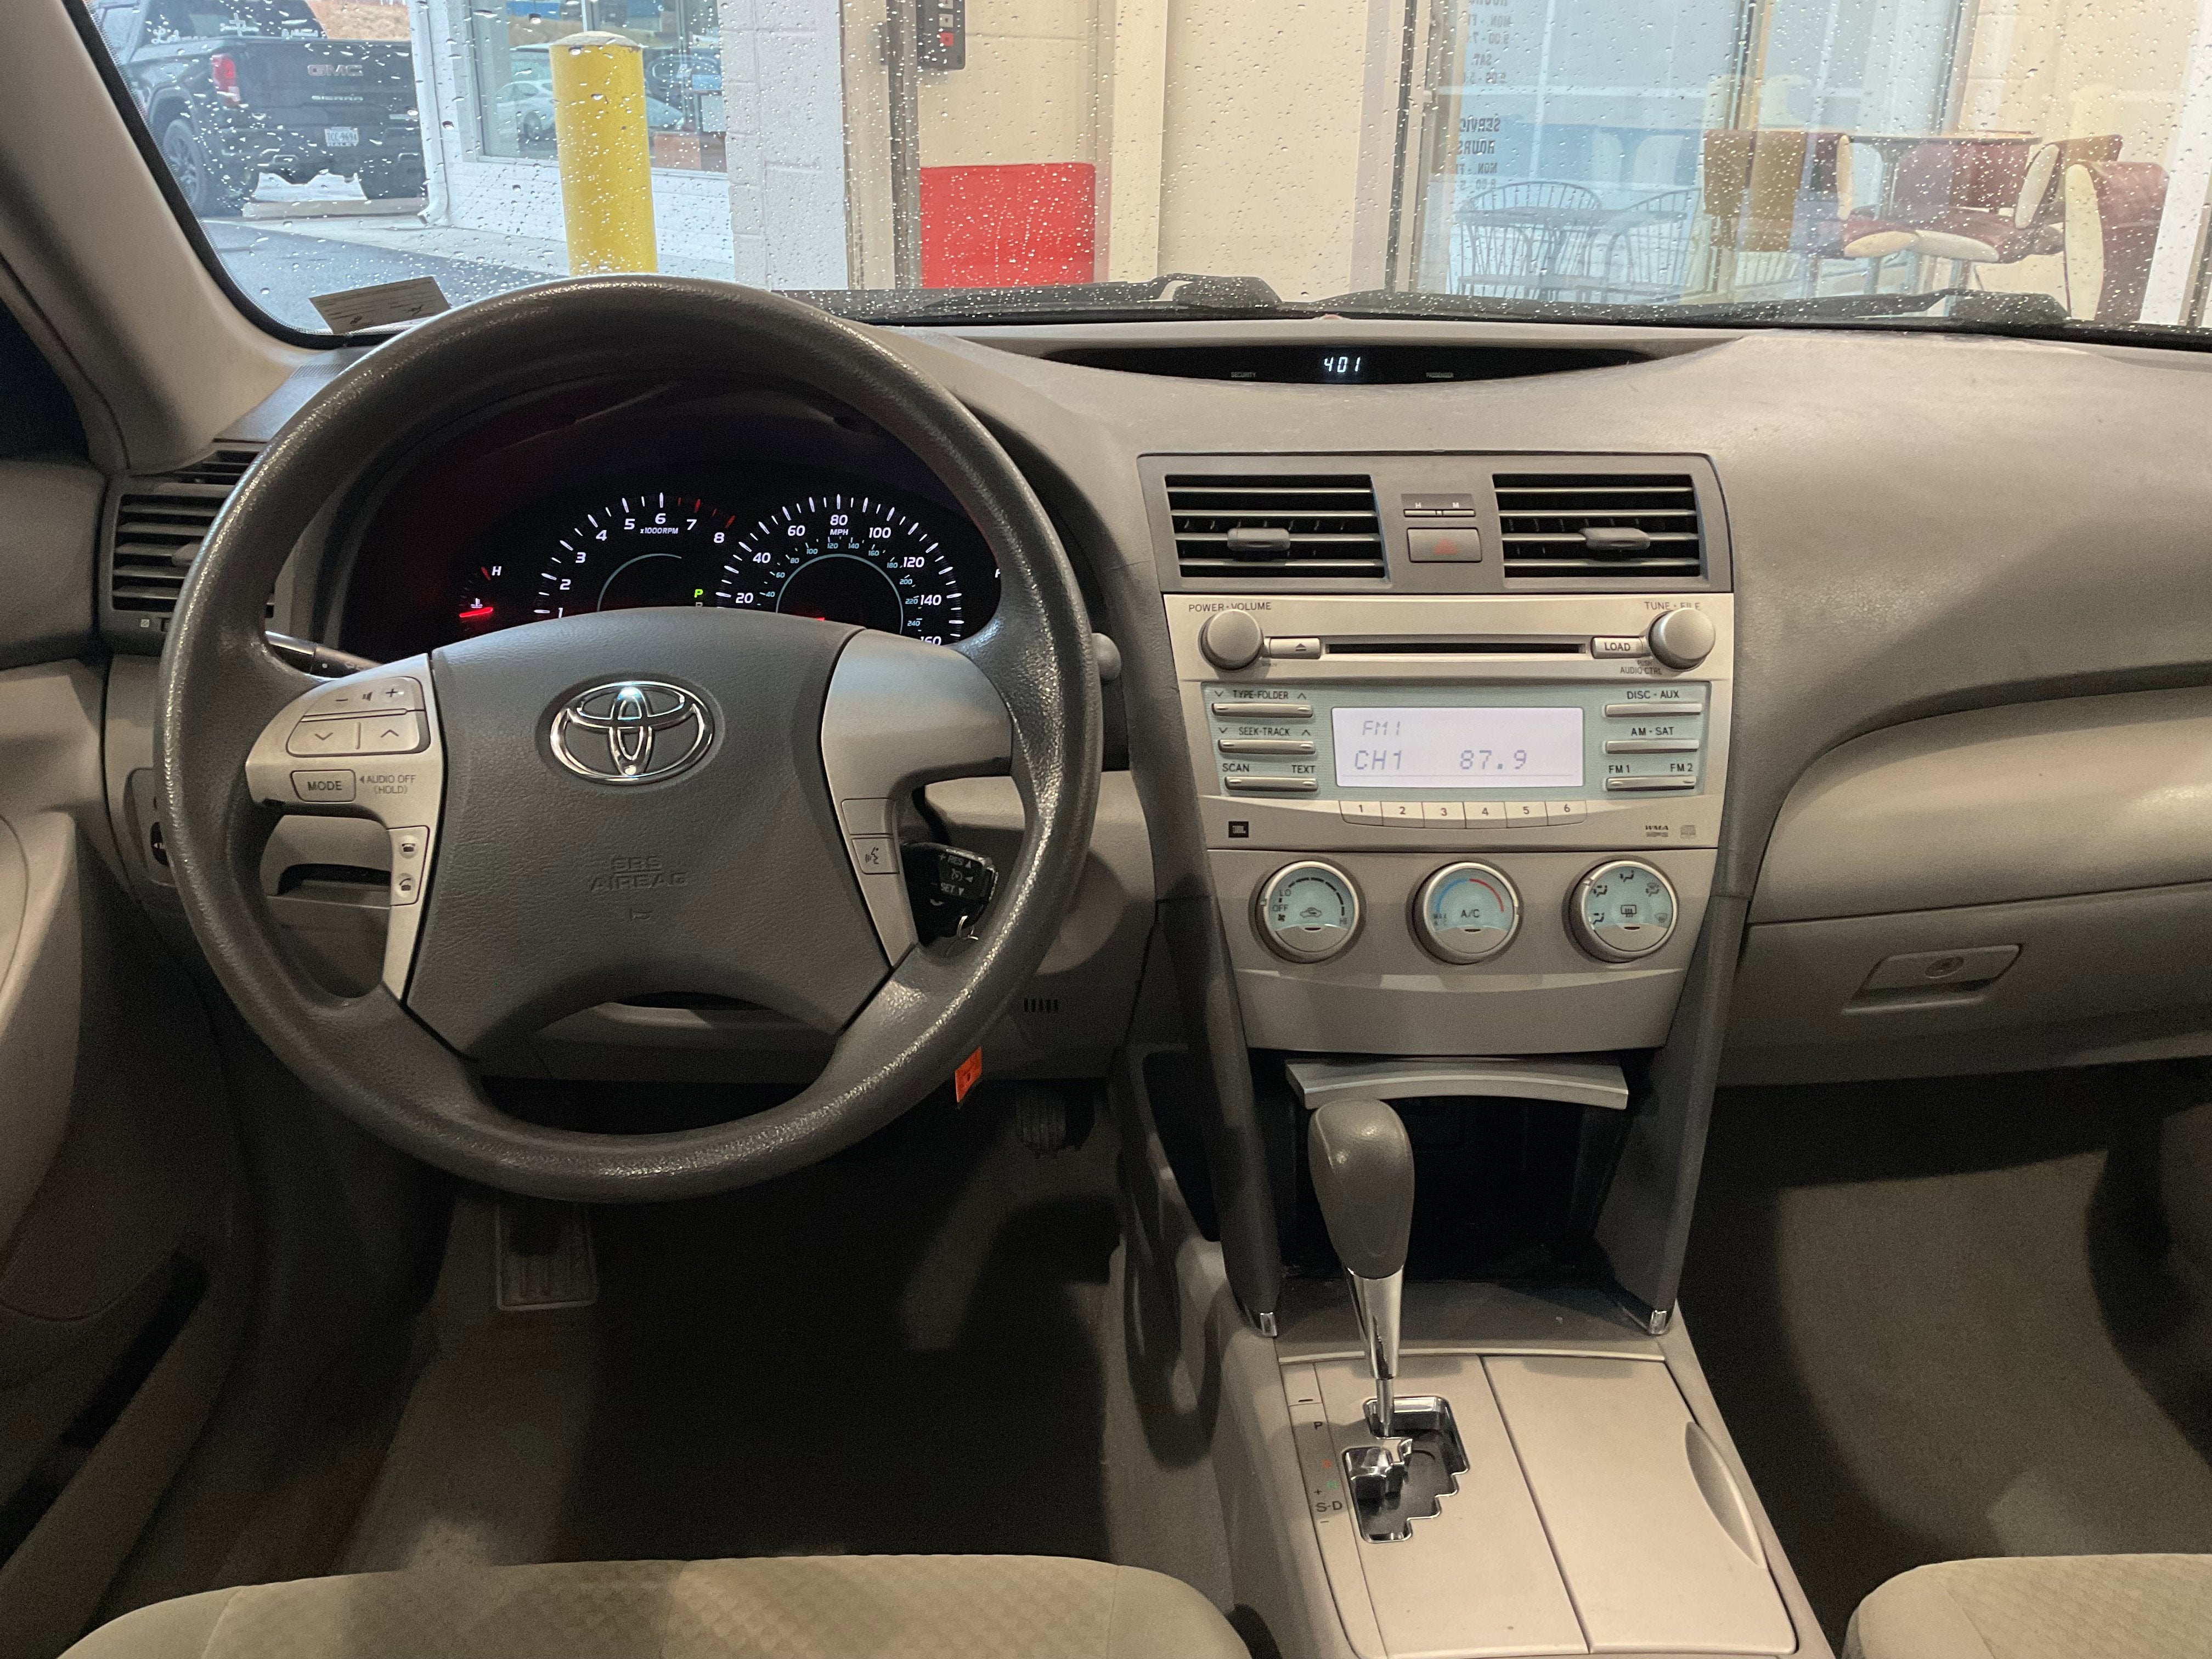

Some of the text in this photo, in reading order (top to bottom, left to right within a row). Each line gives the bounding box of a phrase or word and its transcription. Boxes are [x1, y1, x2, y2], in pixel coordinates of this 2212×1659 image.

[307, 64, 364, 76] GMC
[624, 518, 636, 531] 5
[654, 513, 667, 525] 6
[686, 519, 697, 531] 7
[830, 514, 848, 526] 80
[595, 529, 608, 542] 4
[787, 524, 806, 537] 60
[868, 527, 891, 539] 100
[713, 532, 725, 544] 8
[575, 552, 586, 564] 3
[752, 552, 771, 565] 40
[902, 556, 926, 569] 120
[492, 566, 503, 577] H
[559, 578, 572, 590] 2
[694, 589, 704, 598] P
[735, 592, 754, 605] 20
[920, 594, 942, 606] 140
[1644, 601, 1671, 611] TUNE
[558, 607, 564, 618] 1
[1188, 602, 1272, 612] POWER VOLUME
[1604, 642, 1631, 652] LOAD
[1627, 690, 1680, 699] DISC AUX
[1631, 726, 1675, 736] AM SAT
[1354, 749, 1527, 770] CH1 87.9
[1222, 763, 1250, 772] SCAN
[1291, 765, 1316, 774] TEXT
[366, 774, 417, 784] AUDIO OFF
[307, 780, 343, 791] MODE
[374, 785, 408, 794] (HOLD)
[1358, 804, 1571, 817] 1 2 3 4 5 6
[1460, 909, 1480, 918] A/C
[1313, 1421, 1323, 1430] P
